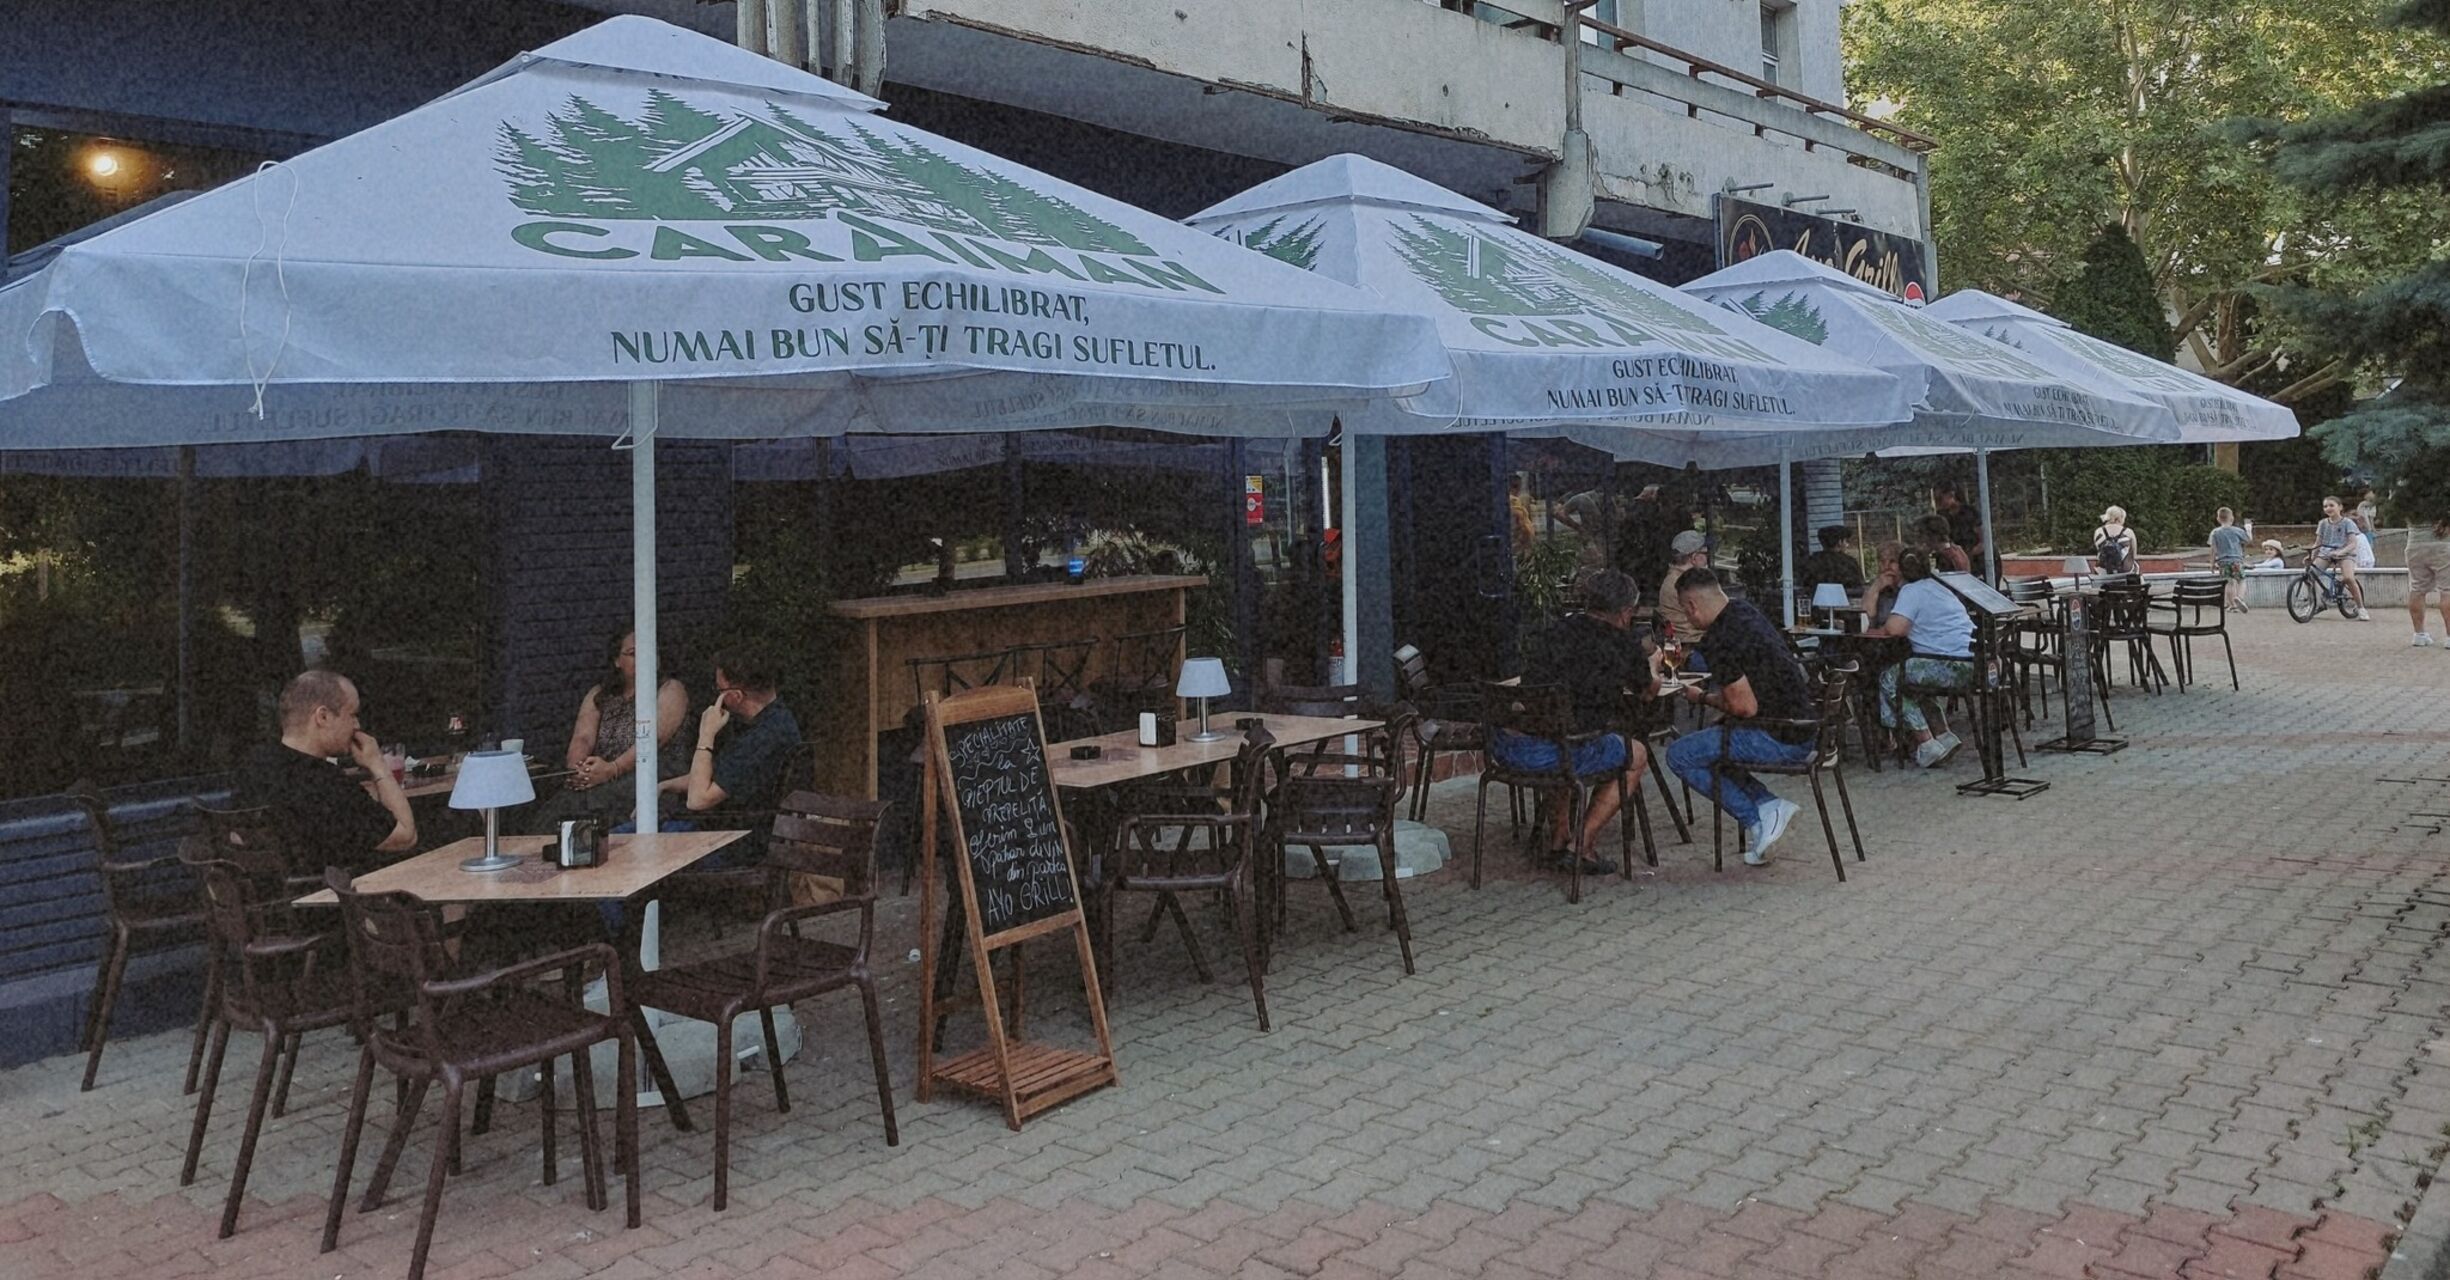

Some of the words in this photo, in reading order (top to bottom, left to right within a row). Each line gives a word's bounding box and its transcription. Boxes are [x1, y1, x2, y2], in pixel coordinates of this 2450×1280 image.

[511, 208, 1227, 294] CARAIMAN
[788, 281, 887, 313] GUST
[901, 280, 1090, 326] ECHILIBRAT,
[610, 328, 756, 364] NUMAI
[771, 326, 850, 360] BUN
[863, 315, 949, 360] SĂ-ȚI
[964, 325, 1063, 360] TRAGI
[1072, 334, 1217, 371] SUFLETUL.
[1612, 359, 1653, 379] GUST
[1546, 388, 1601, 410] NUMAI
[1607, 386, 1638, 408] BUN
[1683, 384, 1729, 409] TRAGI
[1732, 390, 1796, 415] SUFLETUL.
[949, 716, 1028, 768] SPECIALITATE
[1019, 766, 1038, 792] DE
[1039, 820, 1057, 836] un
[988, 886, 1013, 926] AYO
